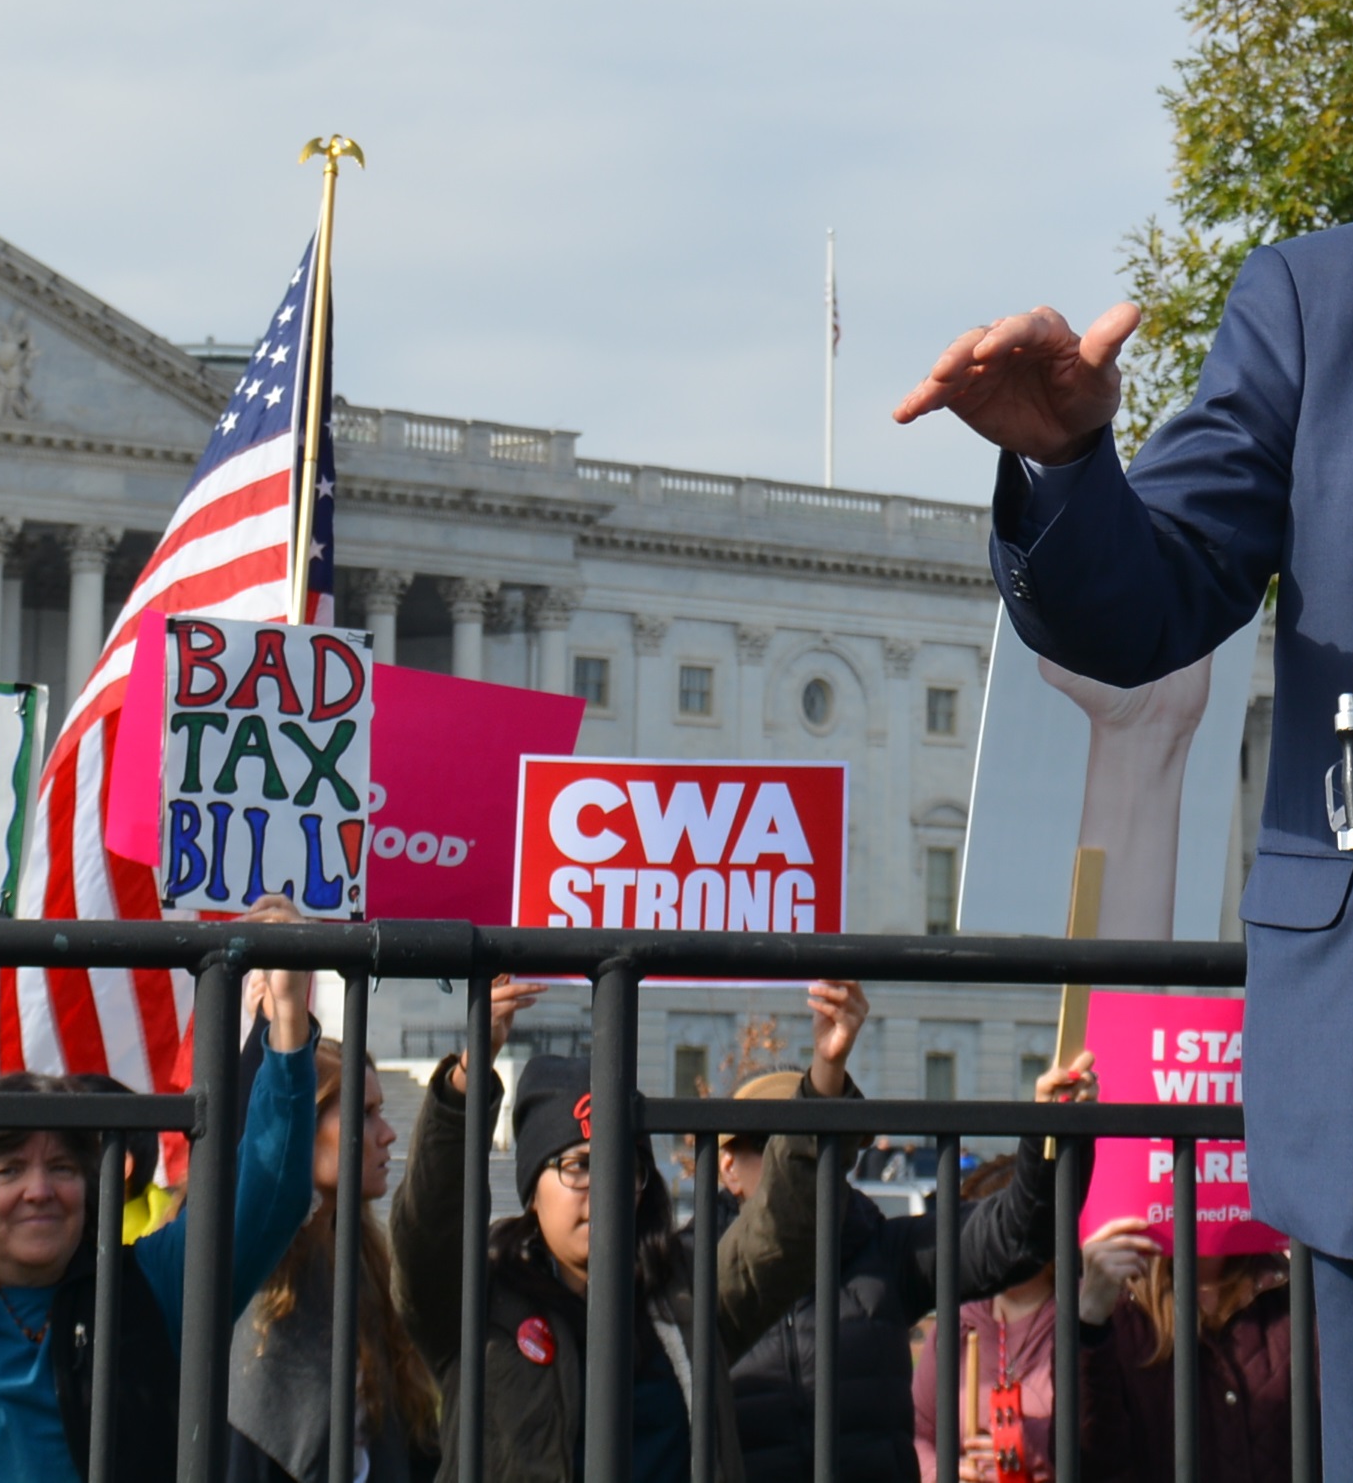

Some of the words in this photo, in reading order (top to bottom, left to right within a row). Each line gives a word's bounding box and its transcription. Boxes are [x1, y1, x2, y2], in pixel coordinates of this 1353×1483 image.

[174, 620, 366, 722] BAD
[170, 711, 361, 812] TAX
[166, 799, 366, 910] BILL!
[548, 777, 814, 864] CWA
[548, 866, 815, 933] STRONG
[1153, 1029, 1165, 1061] I
